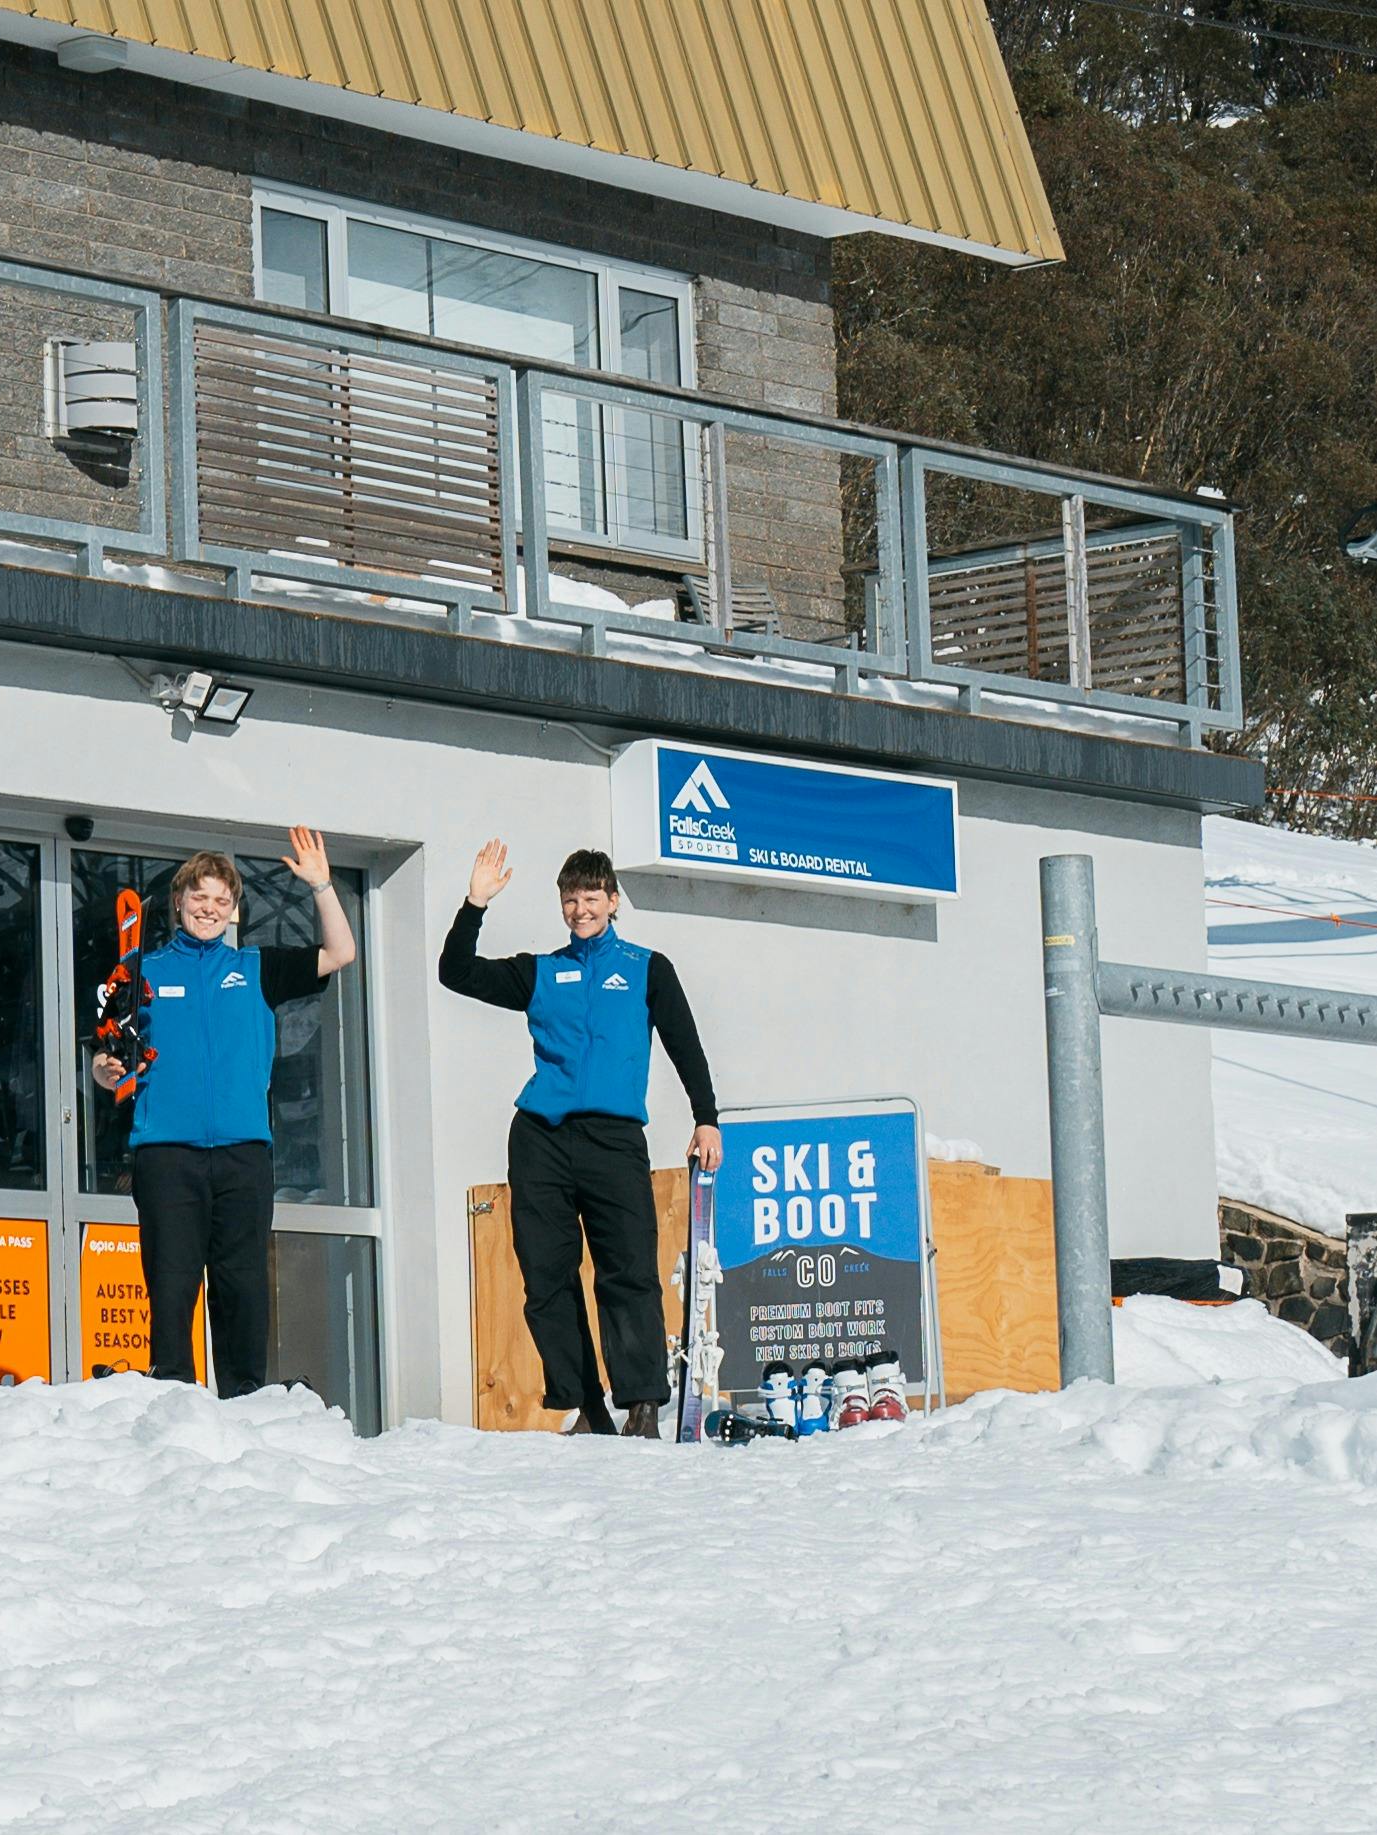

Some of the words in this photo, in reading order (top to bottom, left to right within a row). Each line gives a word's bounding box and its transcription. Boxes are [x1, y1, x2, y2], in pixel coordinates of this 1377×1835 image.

[669, 814, 737, 841] FallsCreek
[678, 840, 731, 856] SPORTS
[749, 848, 769, 864] SKI
[770, 850, 780, 865] &
[780, 851, 823, 871] BOARD
[824, 857, 872, 877] RENTAL
[751, 1142, 830, 1193] SKI
[847, 1140, 876, 1188] &
[753, 1192, 877, 1245] BOOT
[8, 1236, 32, 1248] PASS
[762, 1267, 788, 1278] FALLS
[796, 1254, 836, 1288] CO
[844, 1262, 870, 1273] CREEK
[96, 1283, 149, 1300] AUSTR
[101, 1307, 135, 1324] BEST
[750, 1303, 811, 1321] PREMIUM
[815, 1301, 850, 1318] BOOT
[855, 1300, 885, 1315] FITS
[750, 1324, 804, 1342] CUSTOM
[808, 1322, 843, 1339] BOOT
[847, 1320, 886, 1336] WORK
[755, 1344, 785, 1362] NEW
[789, 1342, 820, 1360] SKIS
[824, 1342, 834, 1358] &
[838, 1340, 882, 1357] BOOTS
